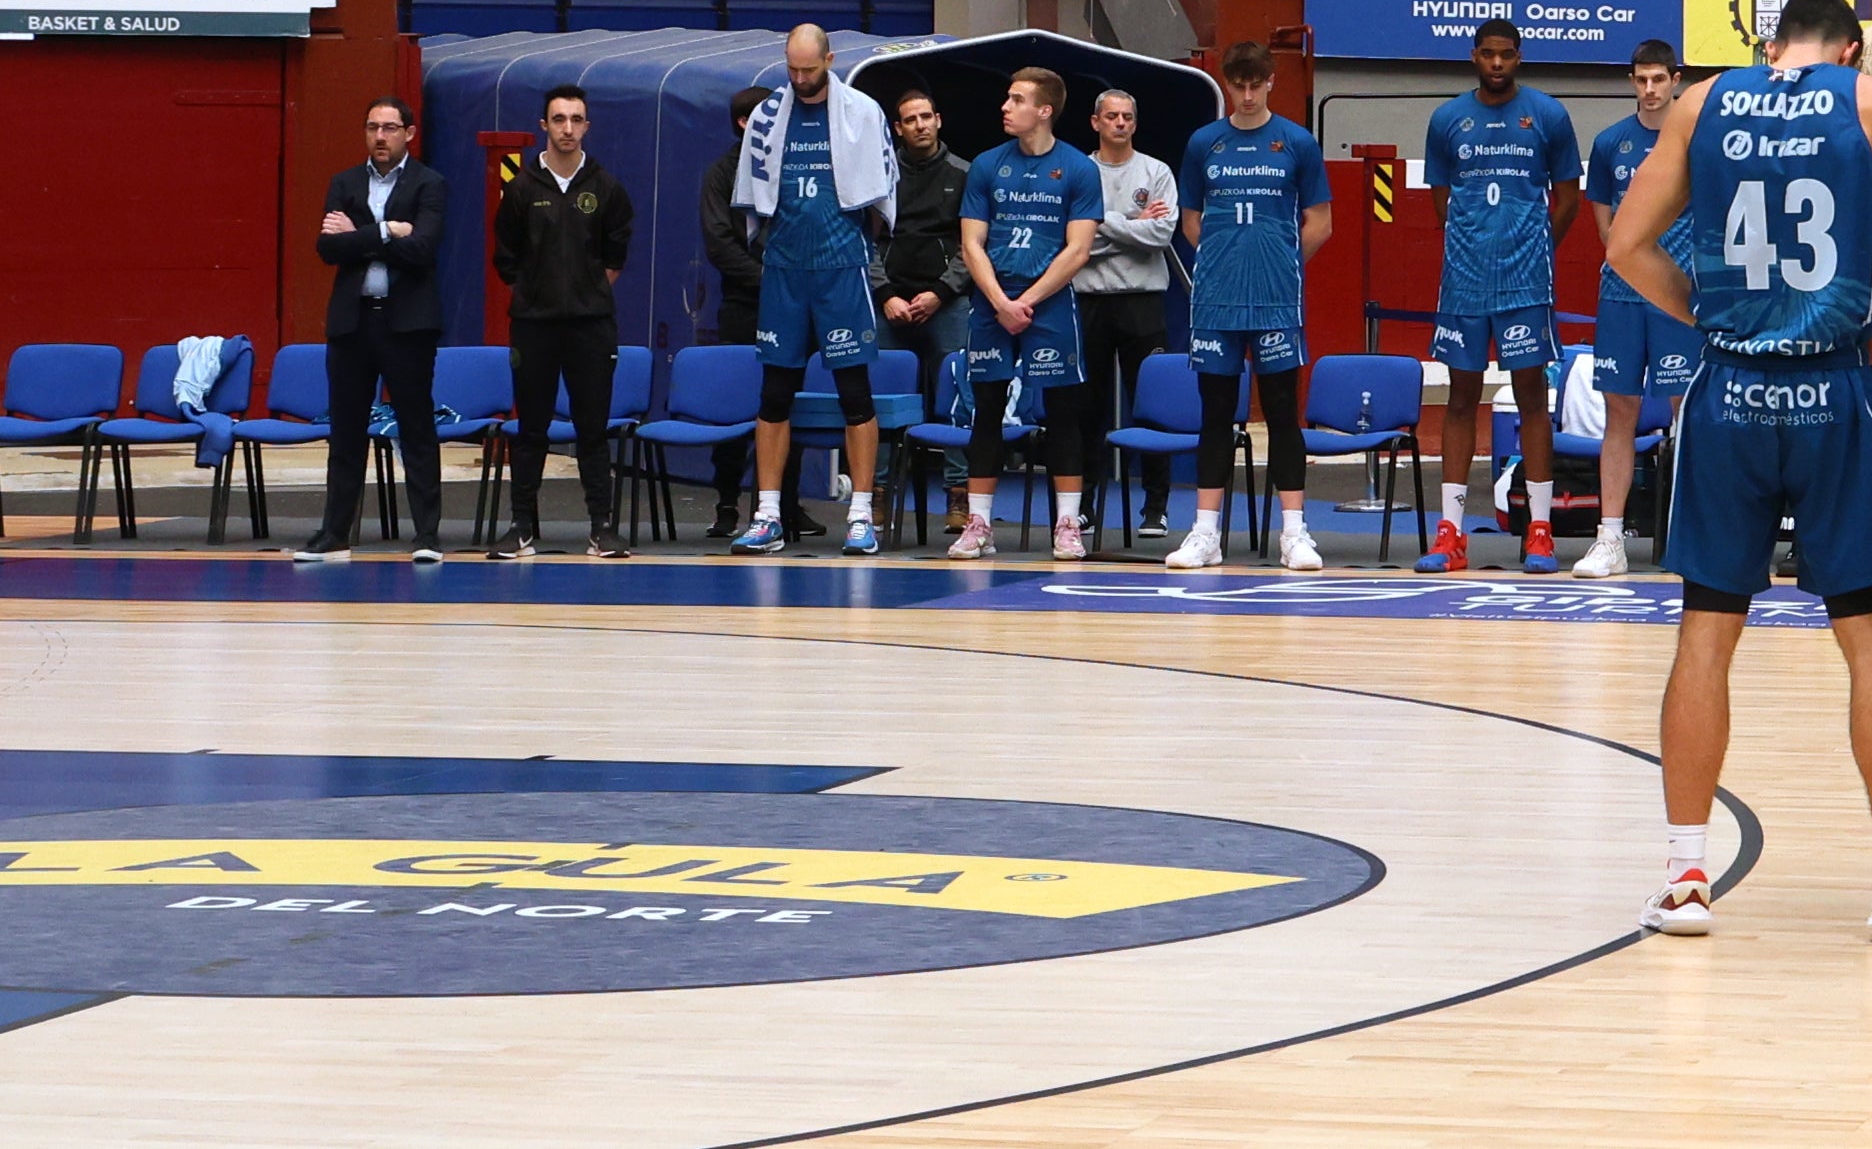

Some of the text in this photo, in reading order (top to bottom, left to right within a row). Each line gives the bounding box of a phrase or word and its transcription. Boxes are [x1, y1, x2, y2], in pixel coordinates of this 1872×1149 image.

[1413, 0, 1636, 23] HYUNDAI Oarso Car
[28, 16, 180, 32] BASKET & SALUD
[1719, 89, 1835, 121] SOLLAZZO
[1474, 143, 1534, 158] Naturklima
[1758, 135, 1826, 158] Irizar
[1222, 165, 1285, 178] Naturklima
[797, 176, 818, 198] 16
[1009, 190, 1062, 205] Naturklima
[1246, 188, 1282, 197] KIROLAK
[1486, 182, 1501, 206] 0
[1235, 202, 1254, 225] 11
[1009, 227, 1034, 249] 22
[1723, 178, 1839, 293] 43
[1656, 368, 1692, 377] HYUNDAI
[1722, 408, 1835, 426] electrodomésticos
[372, 853, 966, 896] GULA
[165, 895, 833, 924] DEL NORTE
